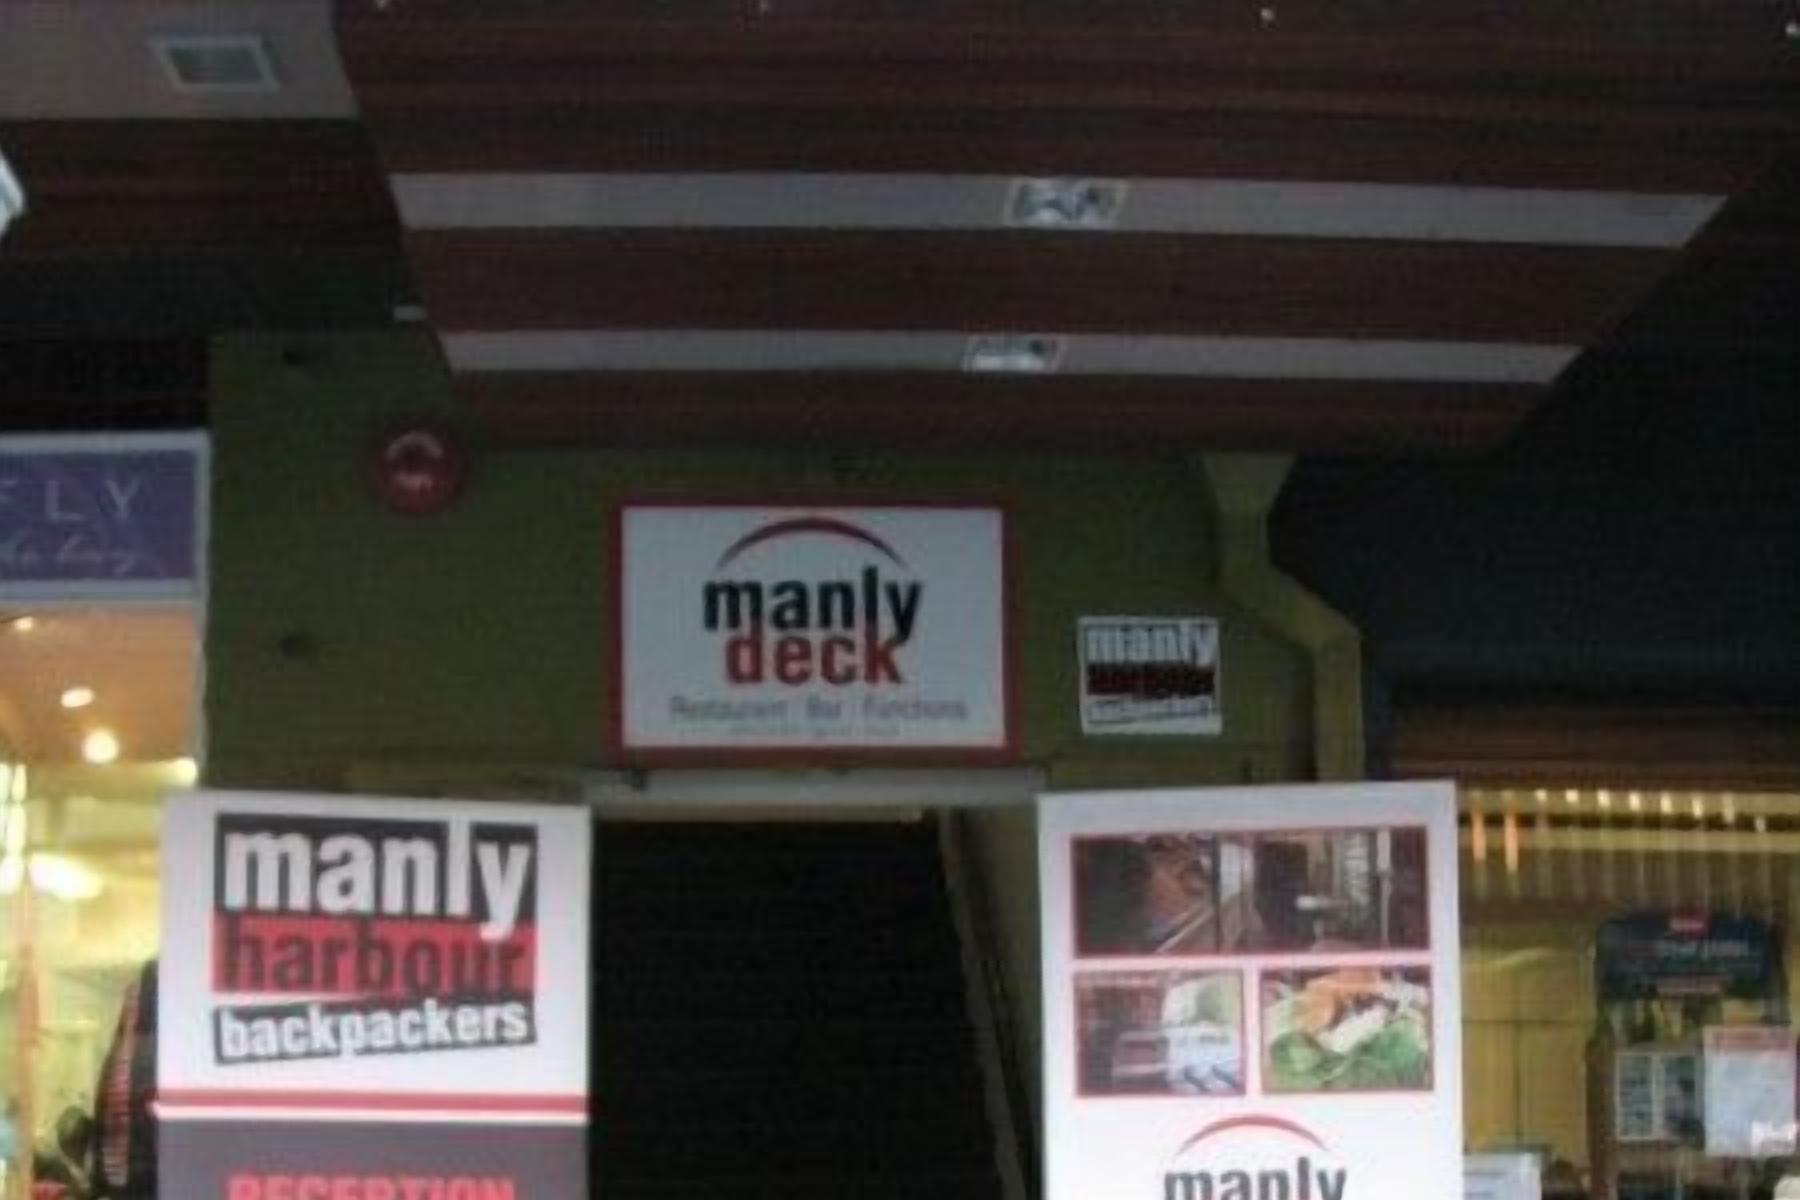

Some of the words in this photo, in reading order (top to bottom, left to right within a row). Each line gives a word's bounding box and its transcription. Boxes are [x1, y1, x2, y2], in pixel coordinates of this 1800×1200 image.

[703, 567, 923, 646] manly
[725, 620, 906, 686] deck
[223, 822, 532, 940] manly
[217, 918, 530, 998] harbour
[219, 998, 530, 1060] backpackers
